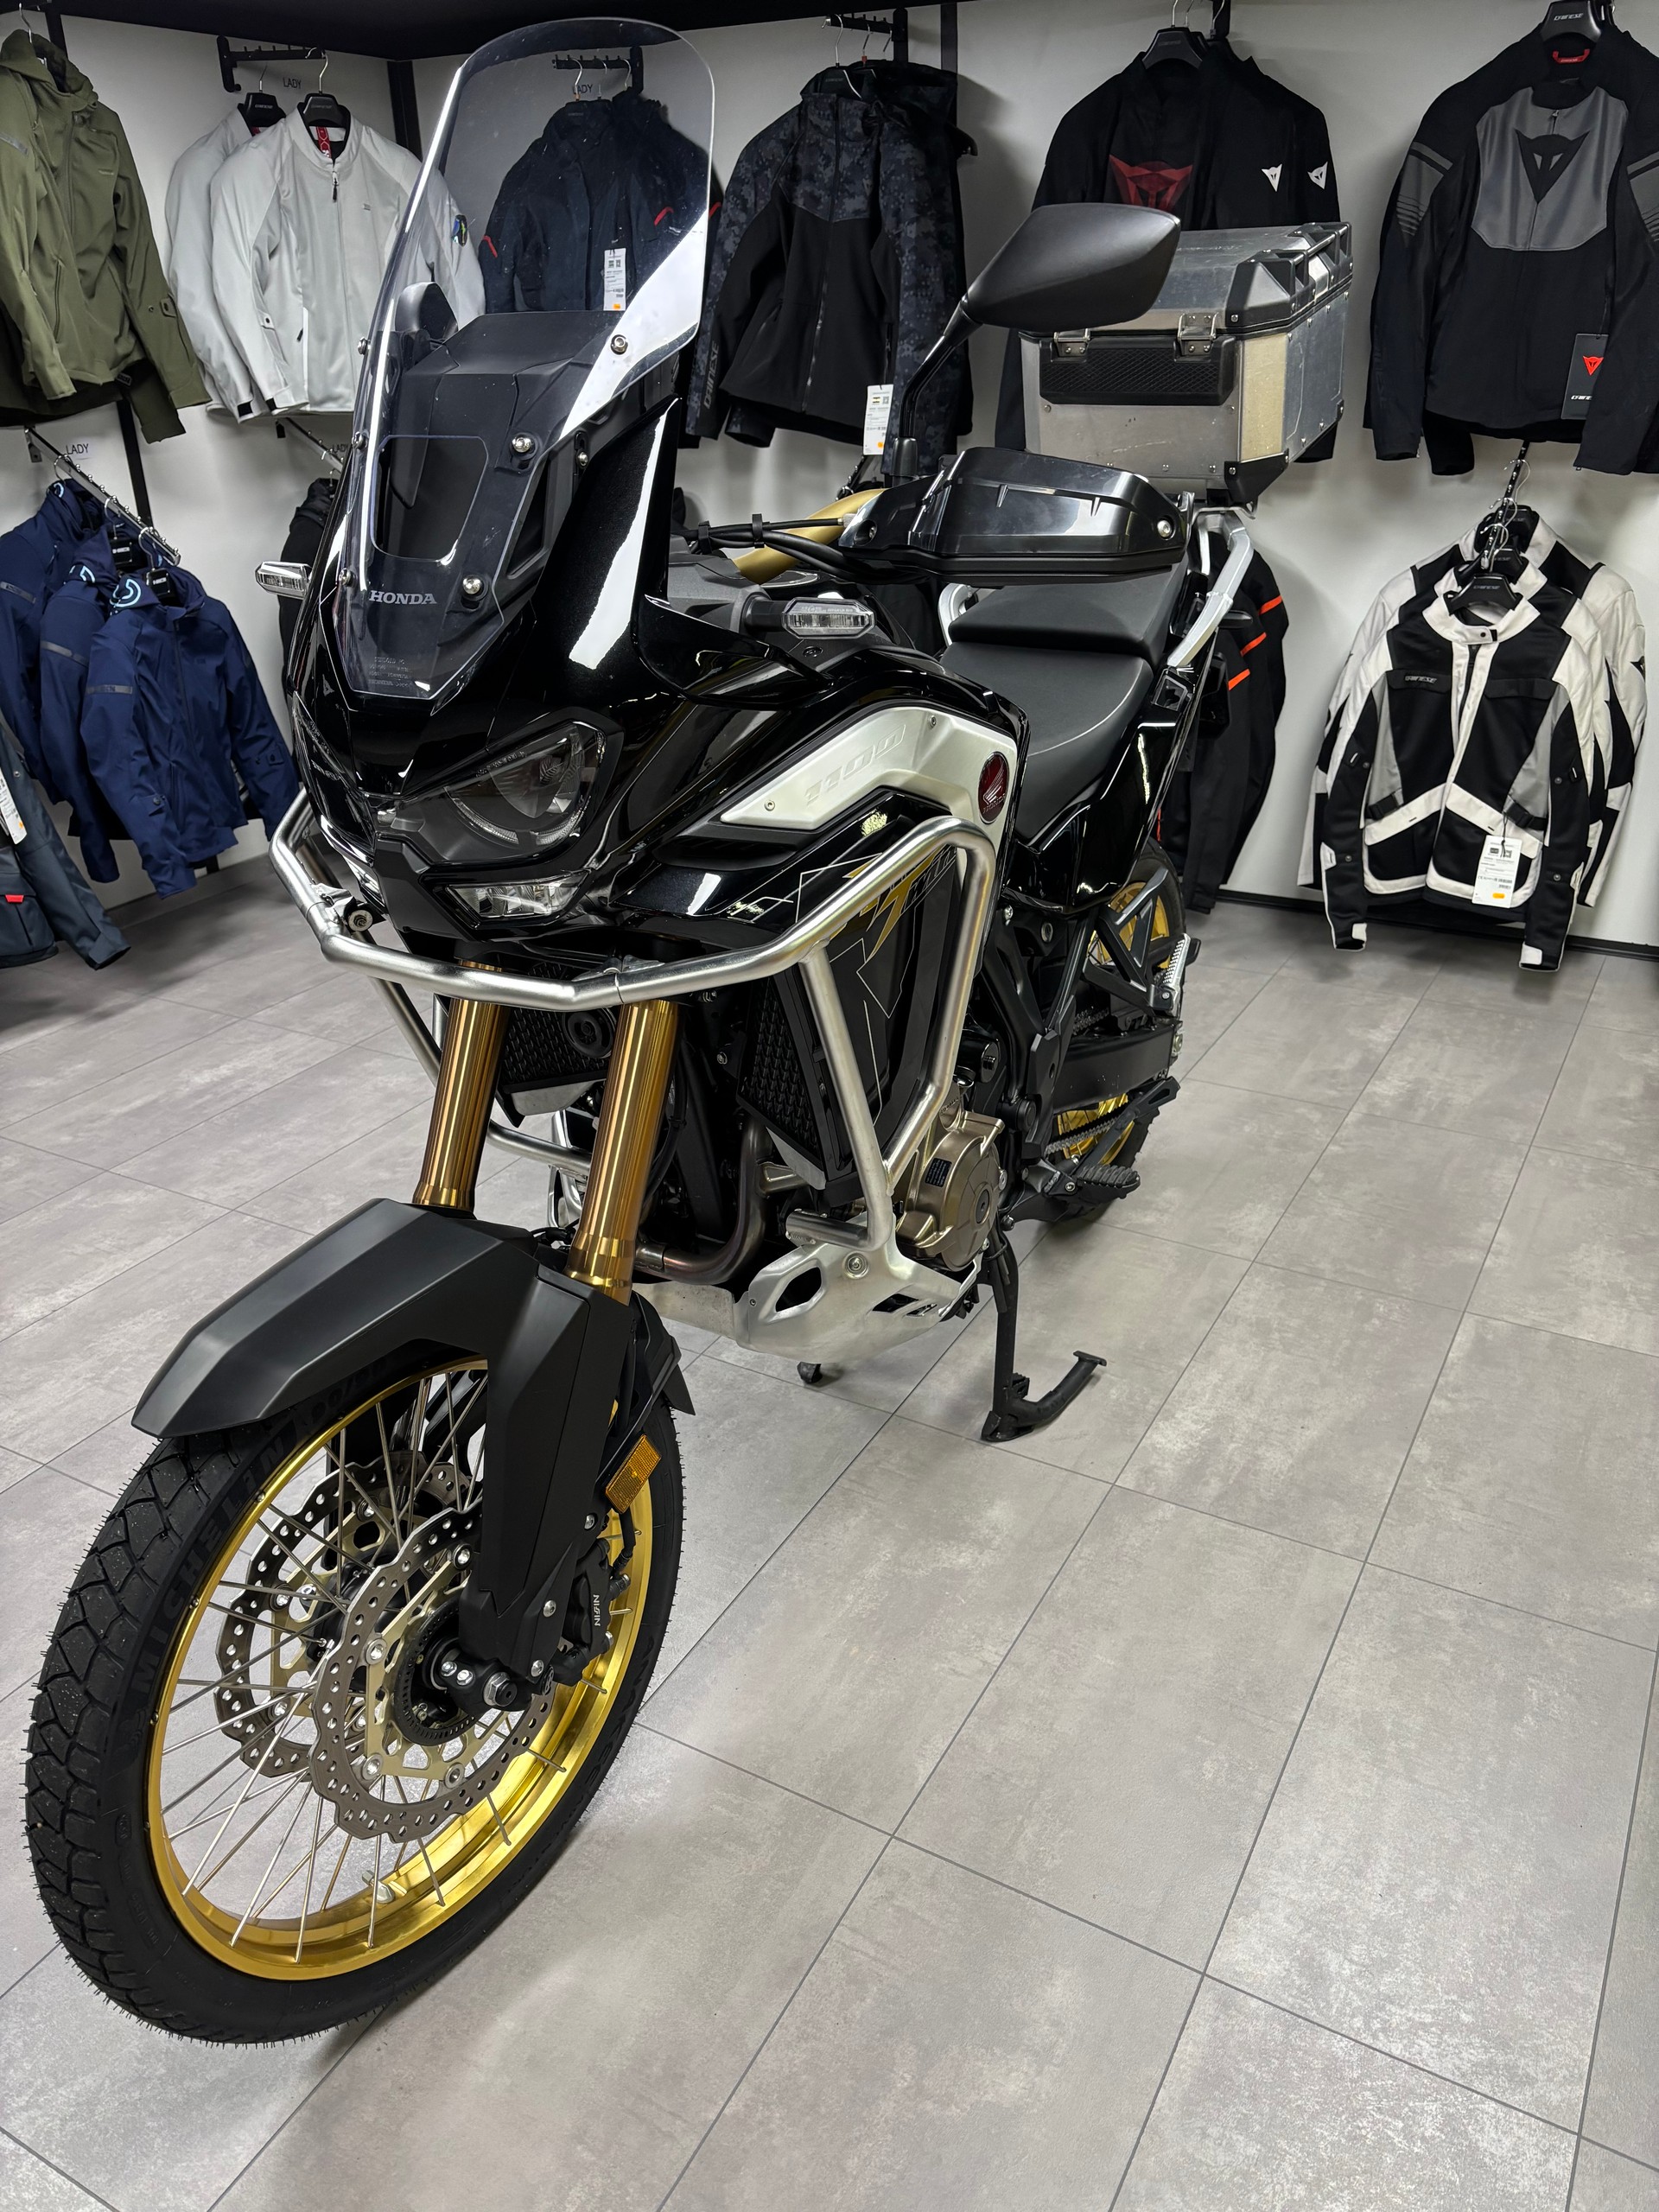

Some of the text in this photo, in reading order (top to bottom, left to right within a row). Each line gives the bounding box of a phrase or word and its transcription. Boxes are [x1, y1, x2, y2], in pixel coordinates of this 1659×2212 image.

[283, 77, 302, 89] LADY
[703, 340, 719, 410] DAINESE
[66, 443, 89, 454] LADY
[369, 589, 437, 605] HONDA
[132, 1433, 287, 1695] MICHELIN
